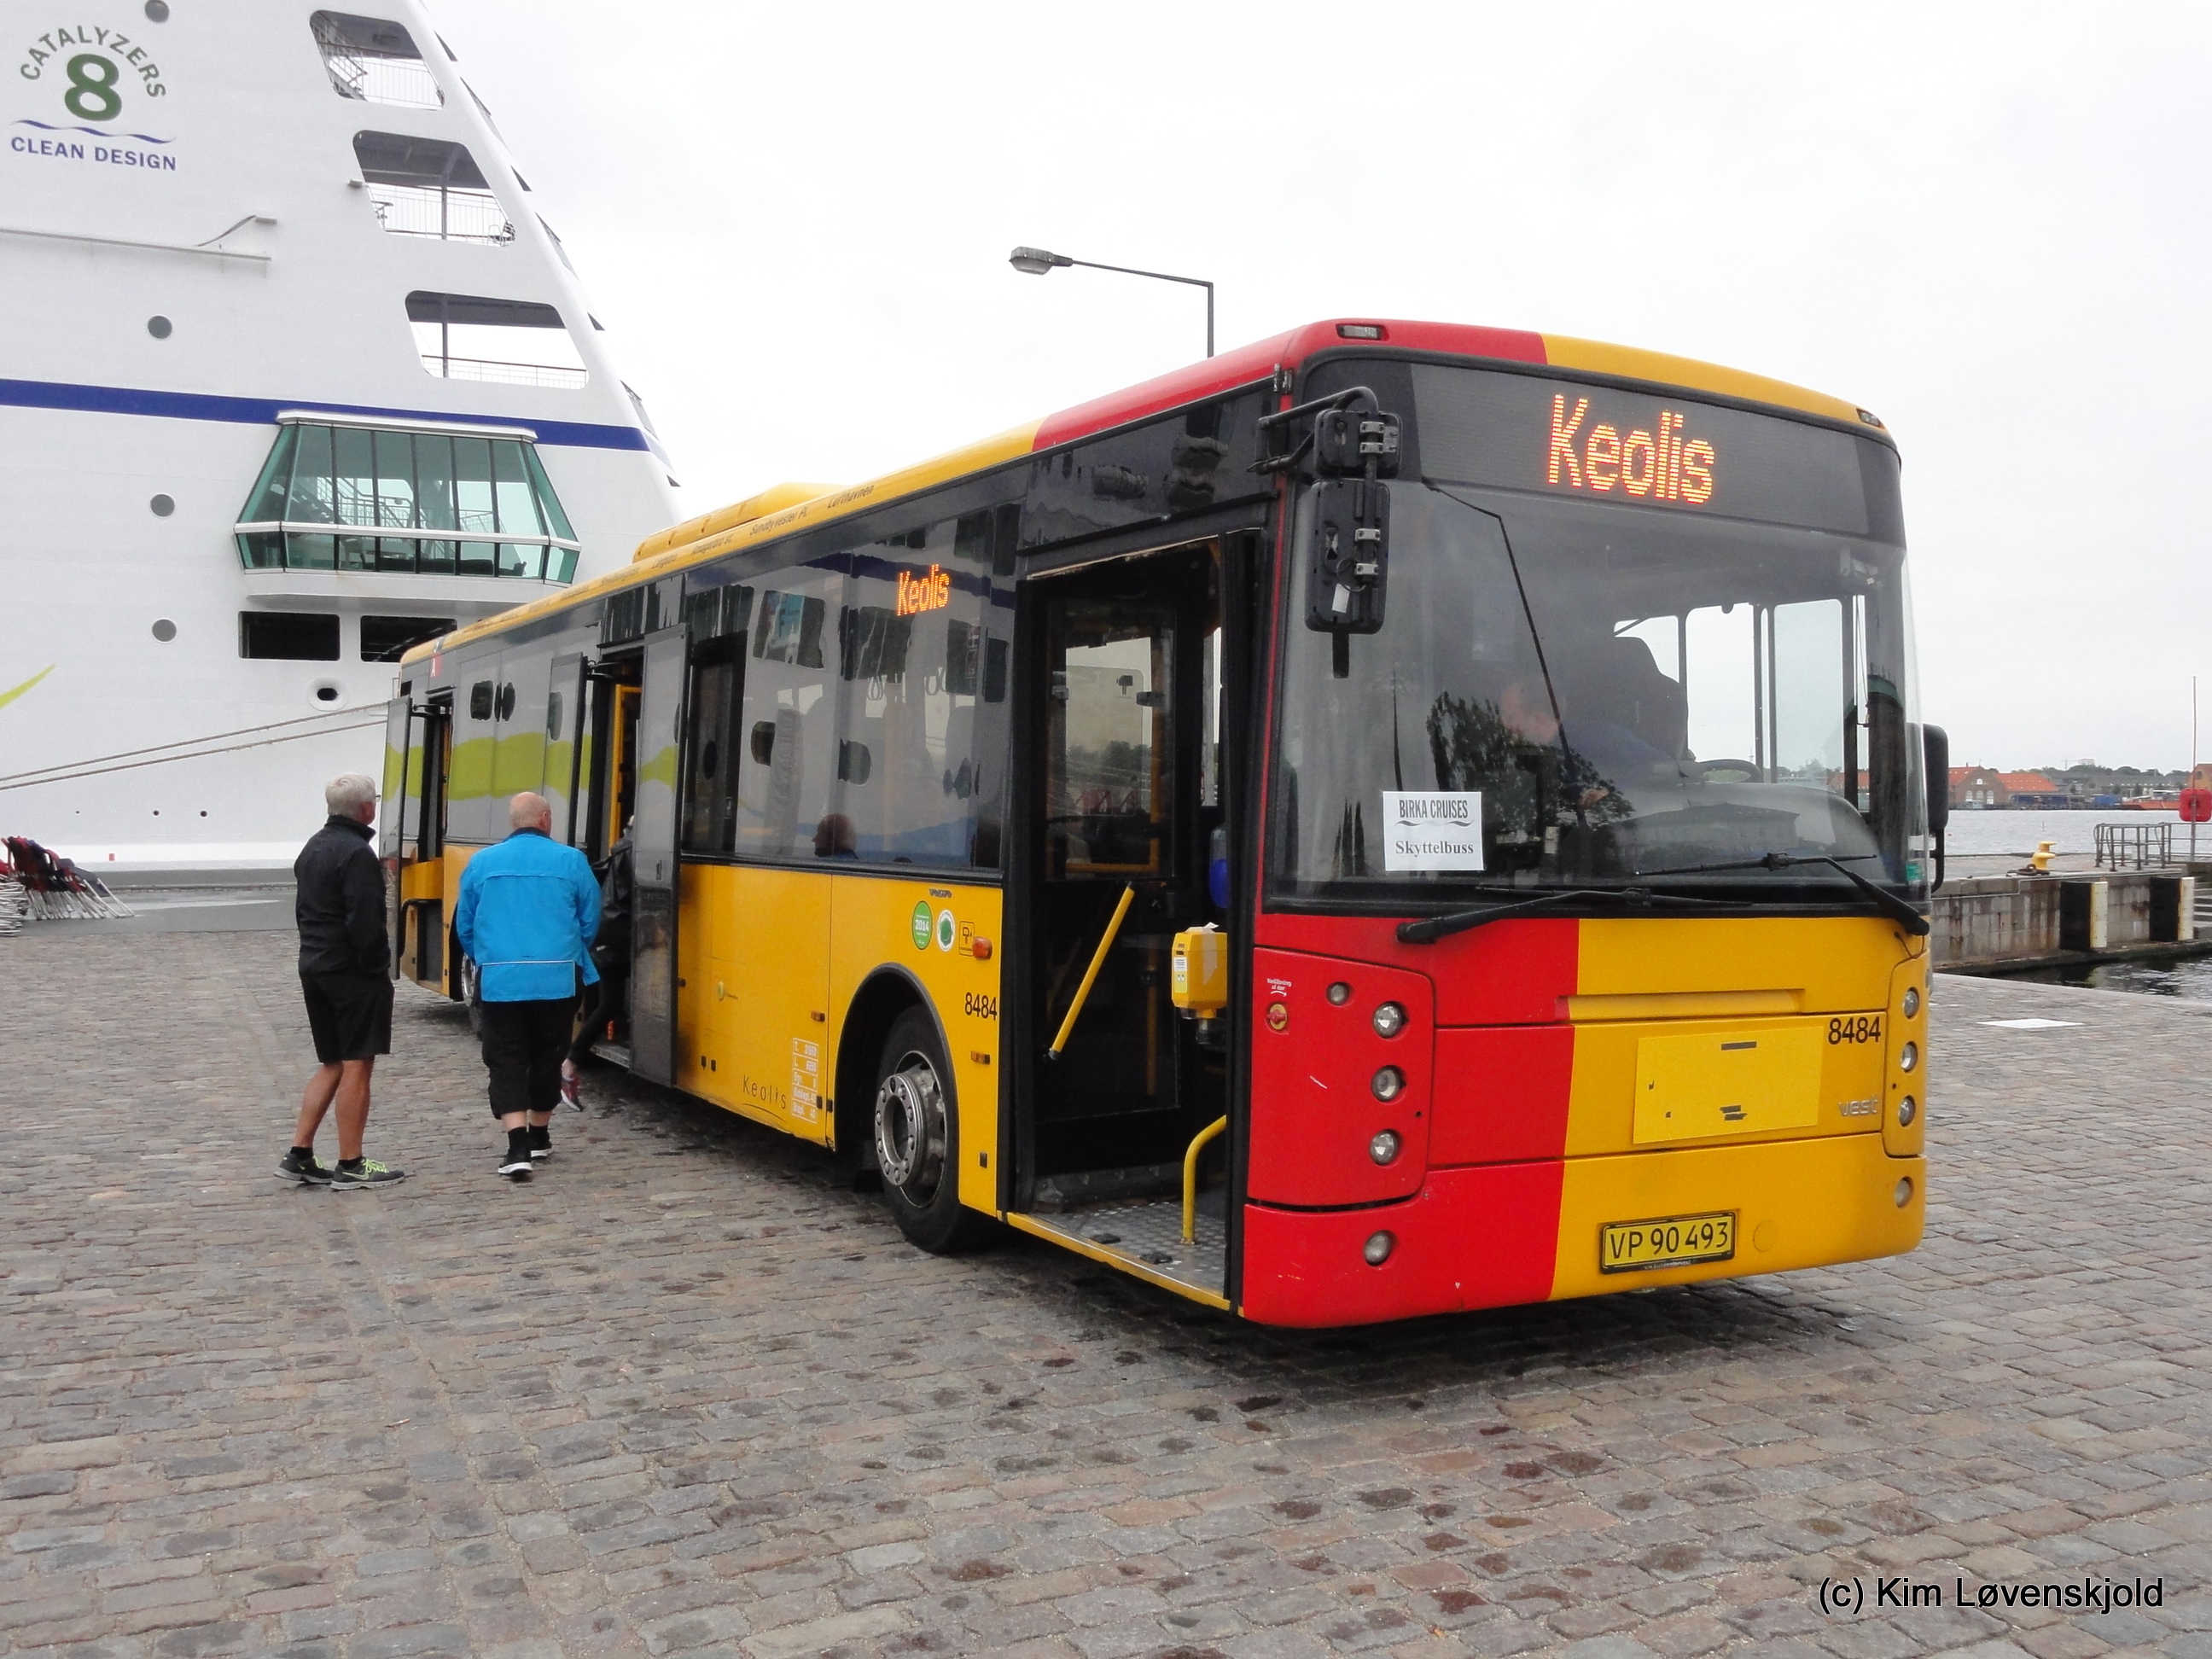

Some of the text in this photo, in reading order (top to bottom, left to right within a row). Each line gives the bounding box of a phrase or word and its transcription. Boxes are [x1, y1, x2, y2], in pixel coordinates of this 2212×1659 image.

[20, 25, 167, 98] CATALYZERS
[64, 53, 123, 122] 8
[11, 137, 176, 171] CLEAN DESIGN
[1547, 393, 1715, 504] Keolis
[897, 564, 950, 616] Keolis
[1399, 799, 1468, 818] BIRKA CRUISES
[1395, 840, 1474, 858] Skyttelbuss
[915, 919, 929, 932] 2014
[964, 992, 998, 1021] 8484
[1828, 1016, 1882, 1045] 8484
[742, 1074, 787, 1109] Keolis
[1838, 1094, 1877, 1117] vest
[1610, 1221, 1728, 1259] VP 90 493
